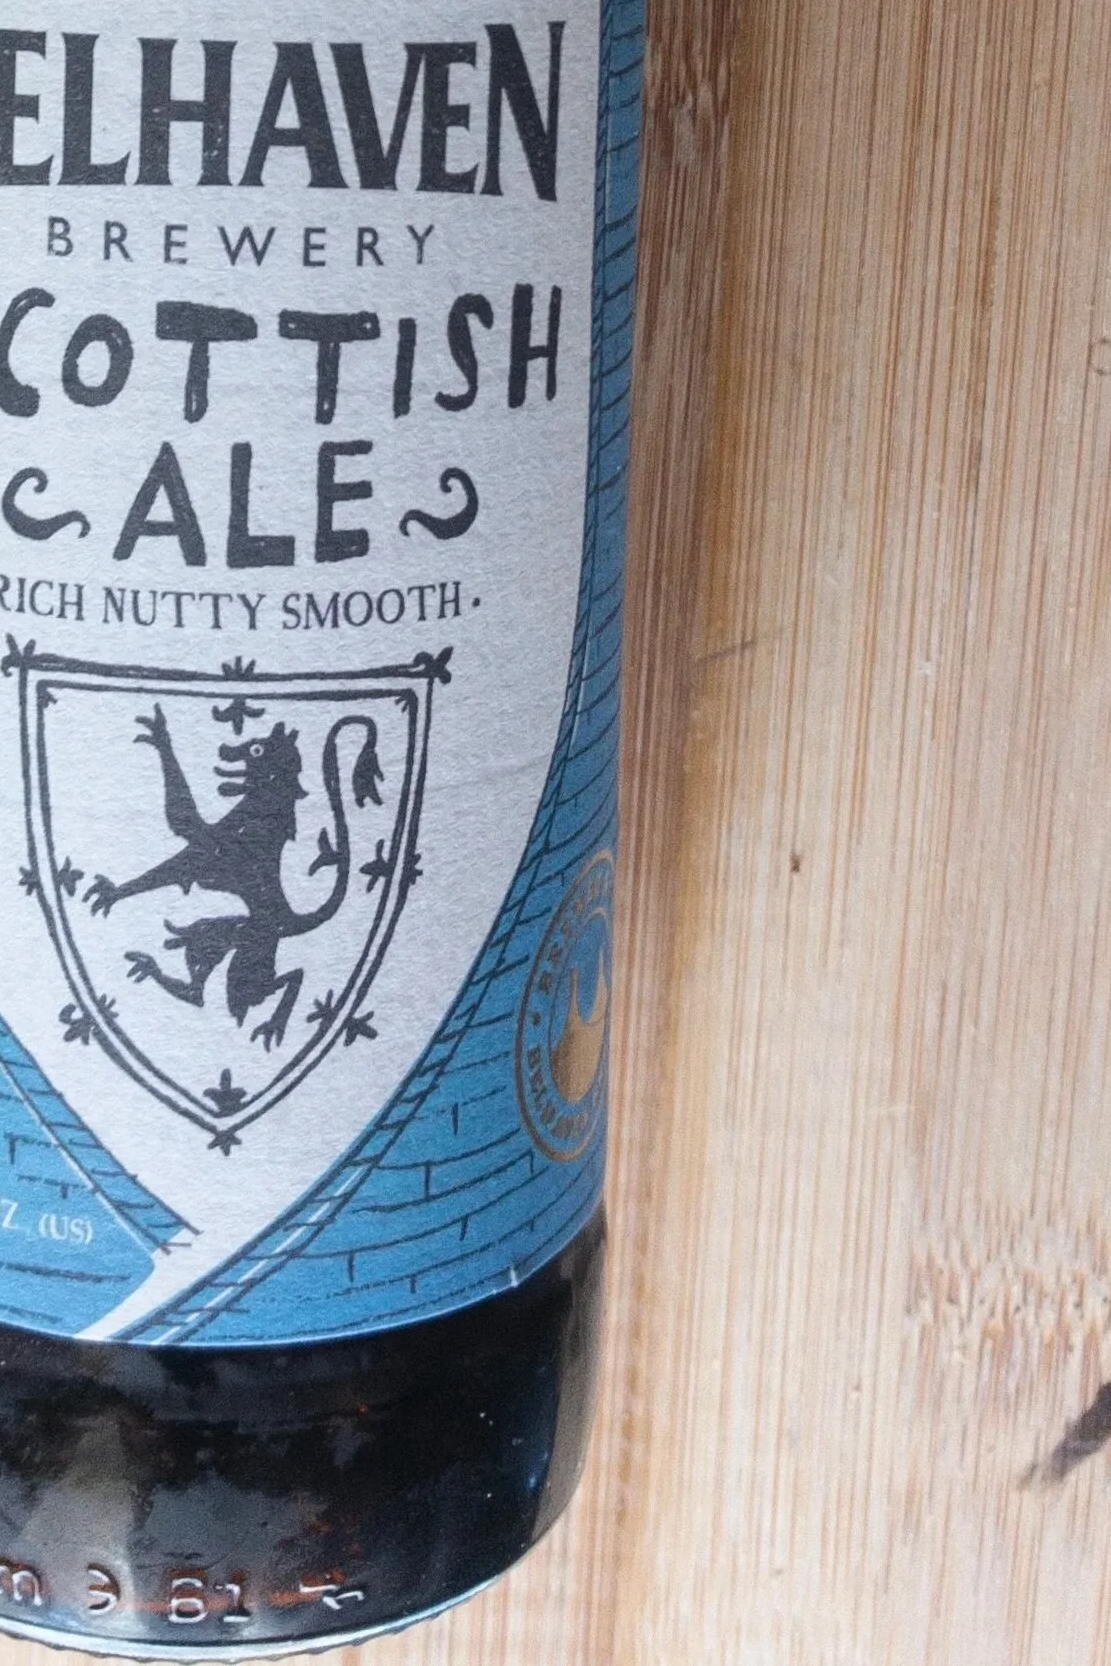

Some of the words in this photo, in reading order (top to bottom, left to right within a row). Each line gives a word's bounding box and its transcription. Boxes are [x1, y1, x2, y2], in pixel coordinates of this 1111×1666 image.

[46, 216, 436, 268] BREWERY
[111, 439, 375, 569] ALE
[102, 586, 267, 631] NUTTY
[281, 581, 463, 631] SMOOTH
